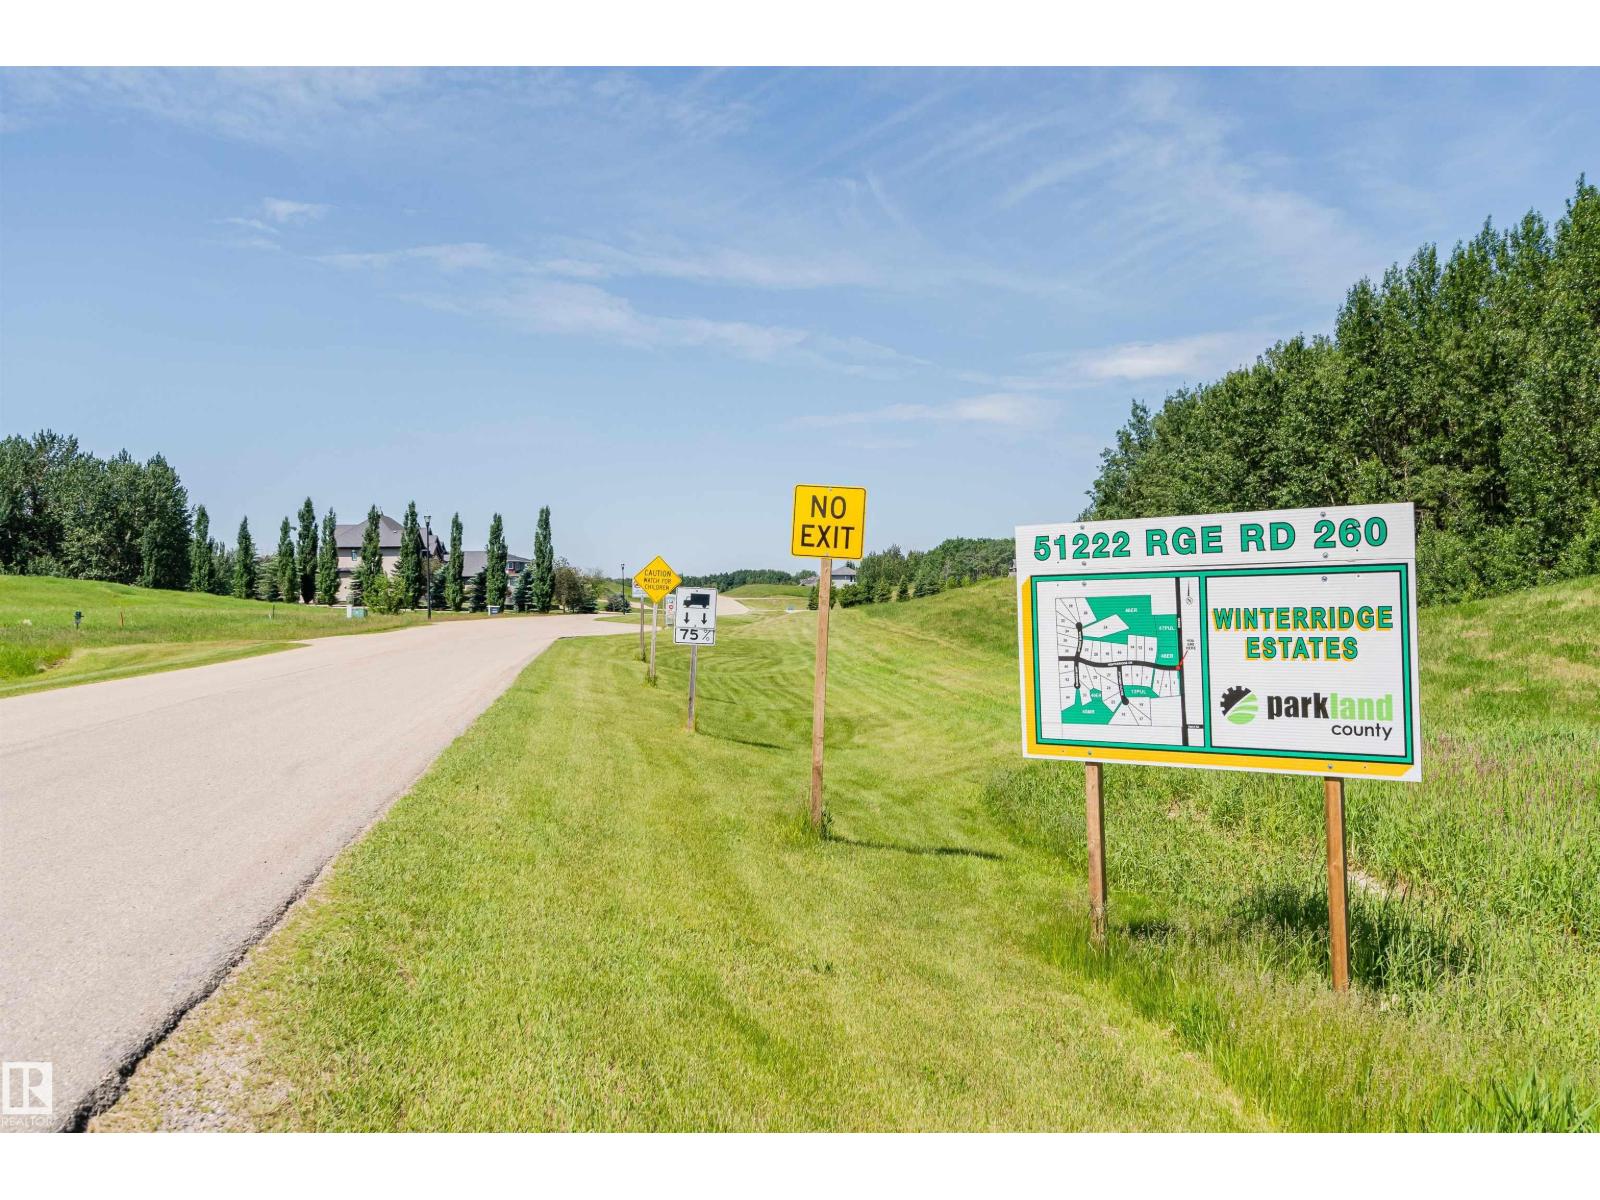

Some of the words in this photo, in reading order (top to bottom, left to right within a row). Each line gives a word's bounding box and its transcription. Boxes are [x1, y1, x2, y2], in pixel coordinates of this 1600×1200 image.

[810, 495, 847, 520] NO
[800, 524, 855, 550] EXIT
[1033, 531, 1131, 562] 51222
[1145, 525, 1224, 556] RGE
[1240, 522, 1297, 552] RD
[1313, 517, 1388, 549] 260
[644, 569, 672, 578] CAUTION
[1213, 605, 1394, 632] WINTERRIDGE
[1245, 636, 1359, 662] ESTATES
[1267, 692, 1393, 722] parkland
[1331, 722, 1393, 741] county
